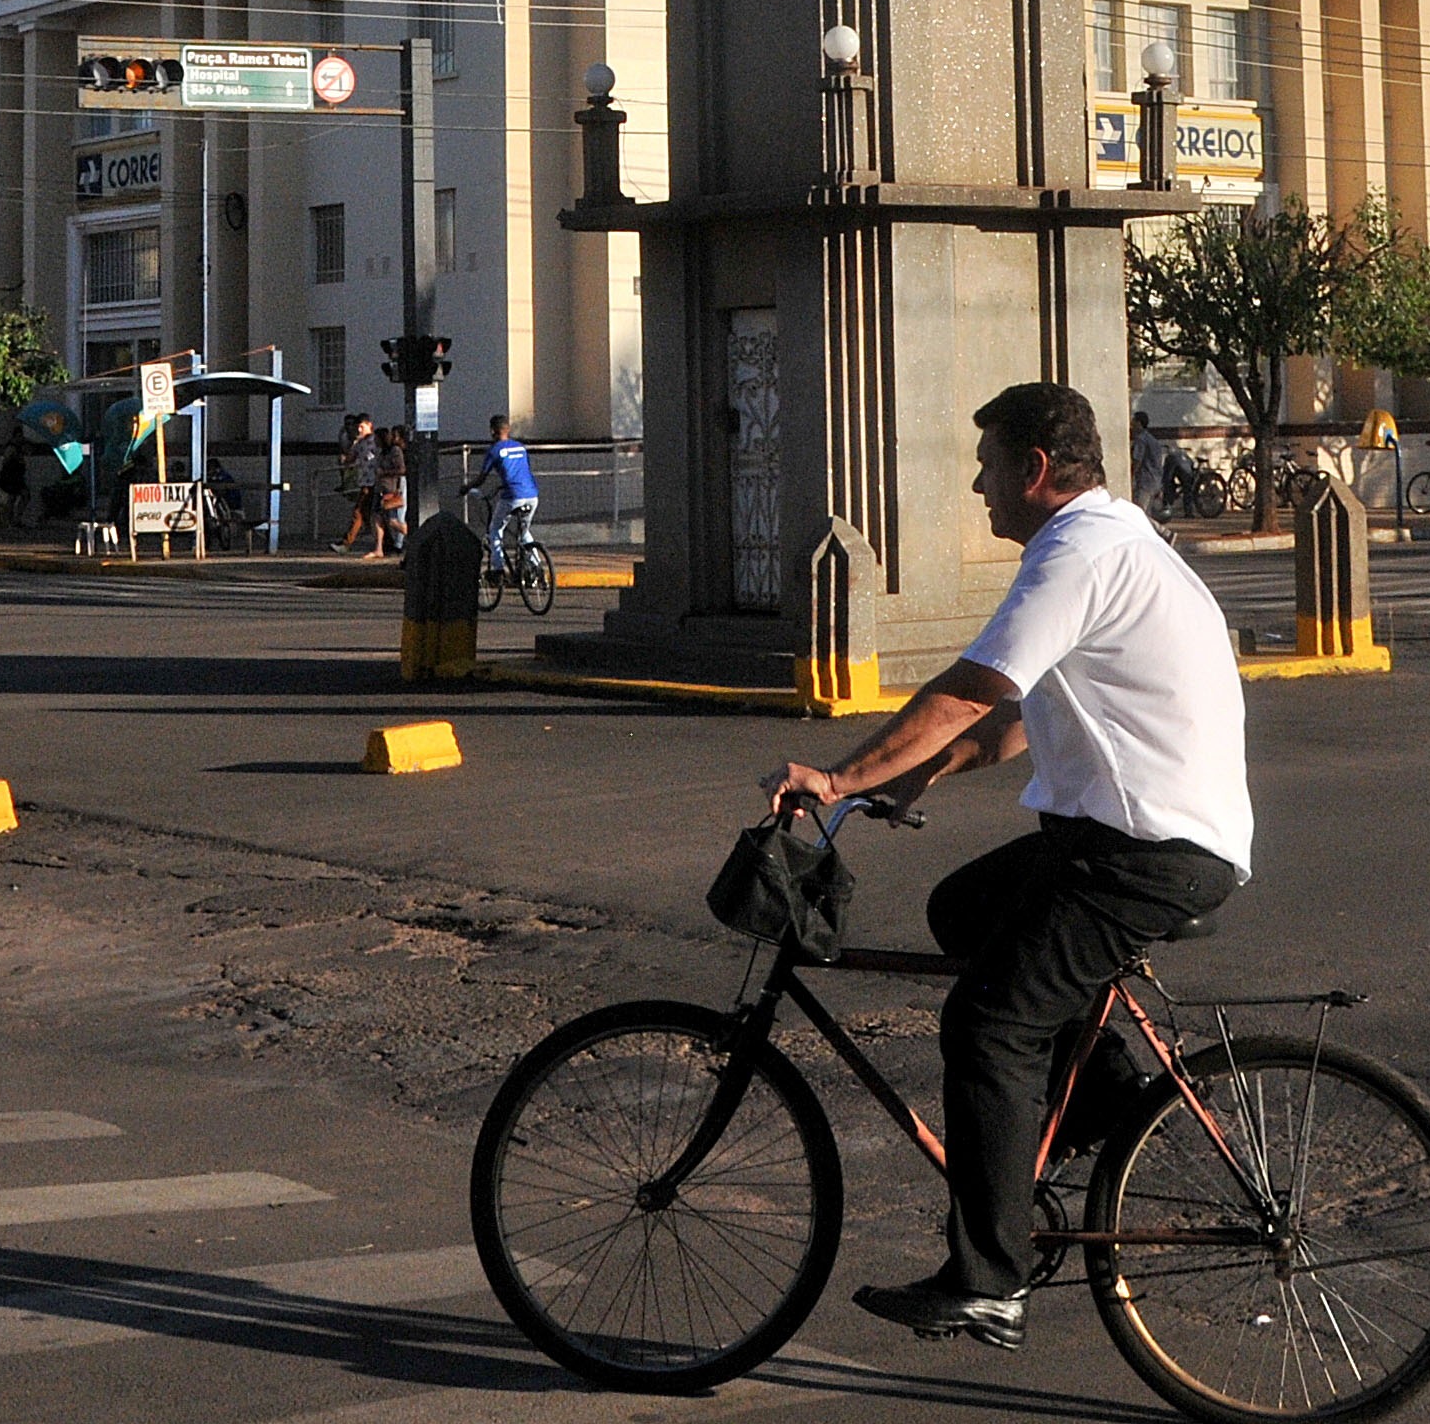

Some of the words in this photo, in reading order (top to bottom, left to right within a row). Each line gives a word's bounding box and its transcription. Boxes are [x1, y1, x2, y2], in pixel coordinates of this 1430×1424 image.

[187, 51, 227, 66] Praça.
[229, 52, 270, 66] Ramez
[271, 53, 306, 67] Tebet
[189, 69, 240, 83] Hospital
[190, 83, 214, 95] São
[216, 84, 250, 96] Paulo
[1135, 125, 1256, 160] RREIOS
[134, 485, 162, 504] MOTO
[163, 484, 186, 503] TAXI
